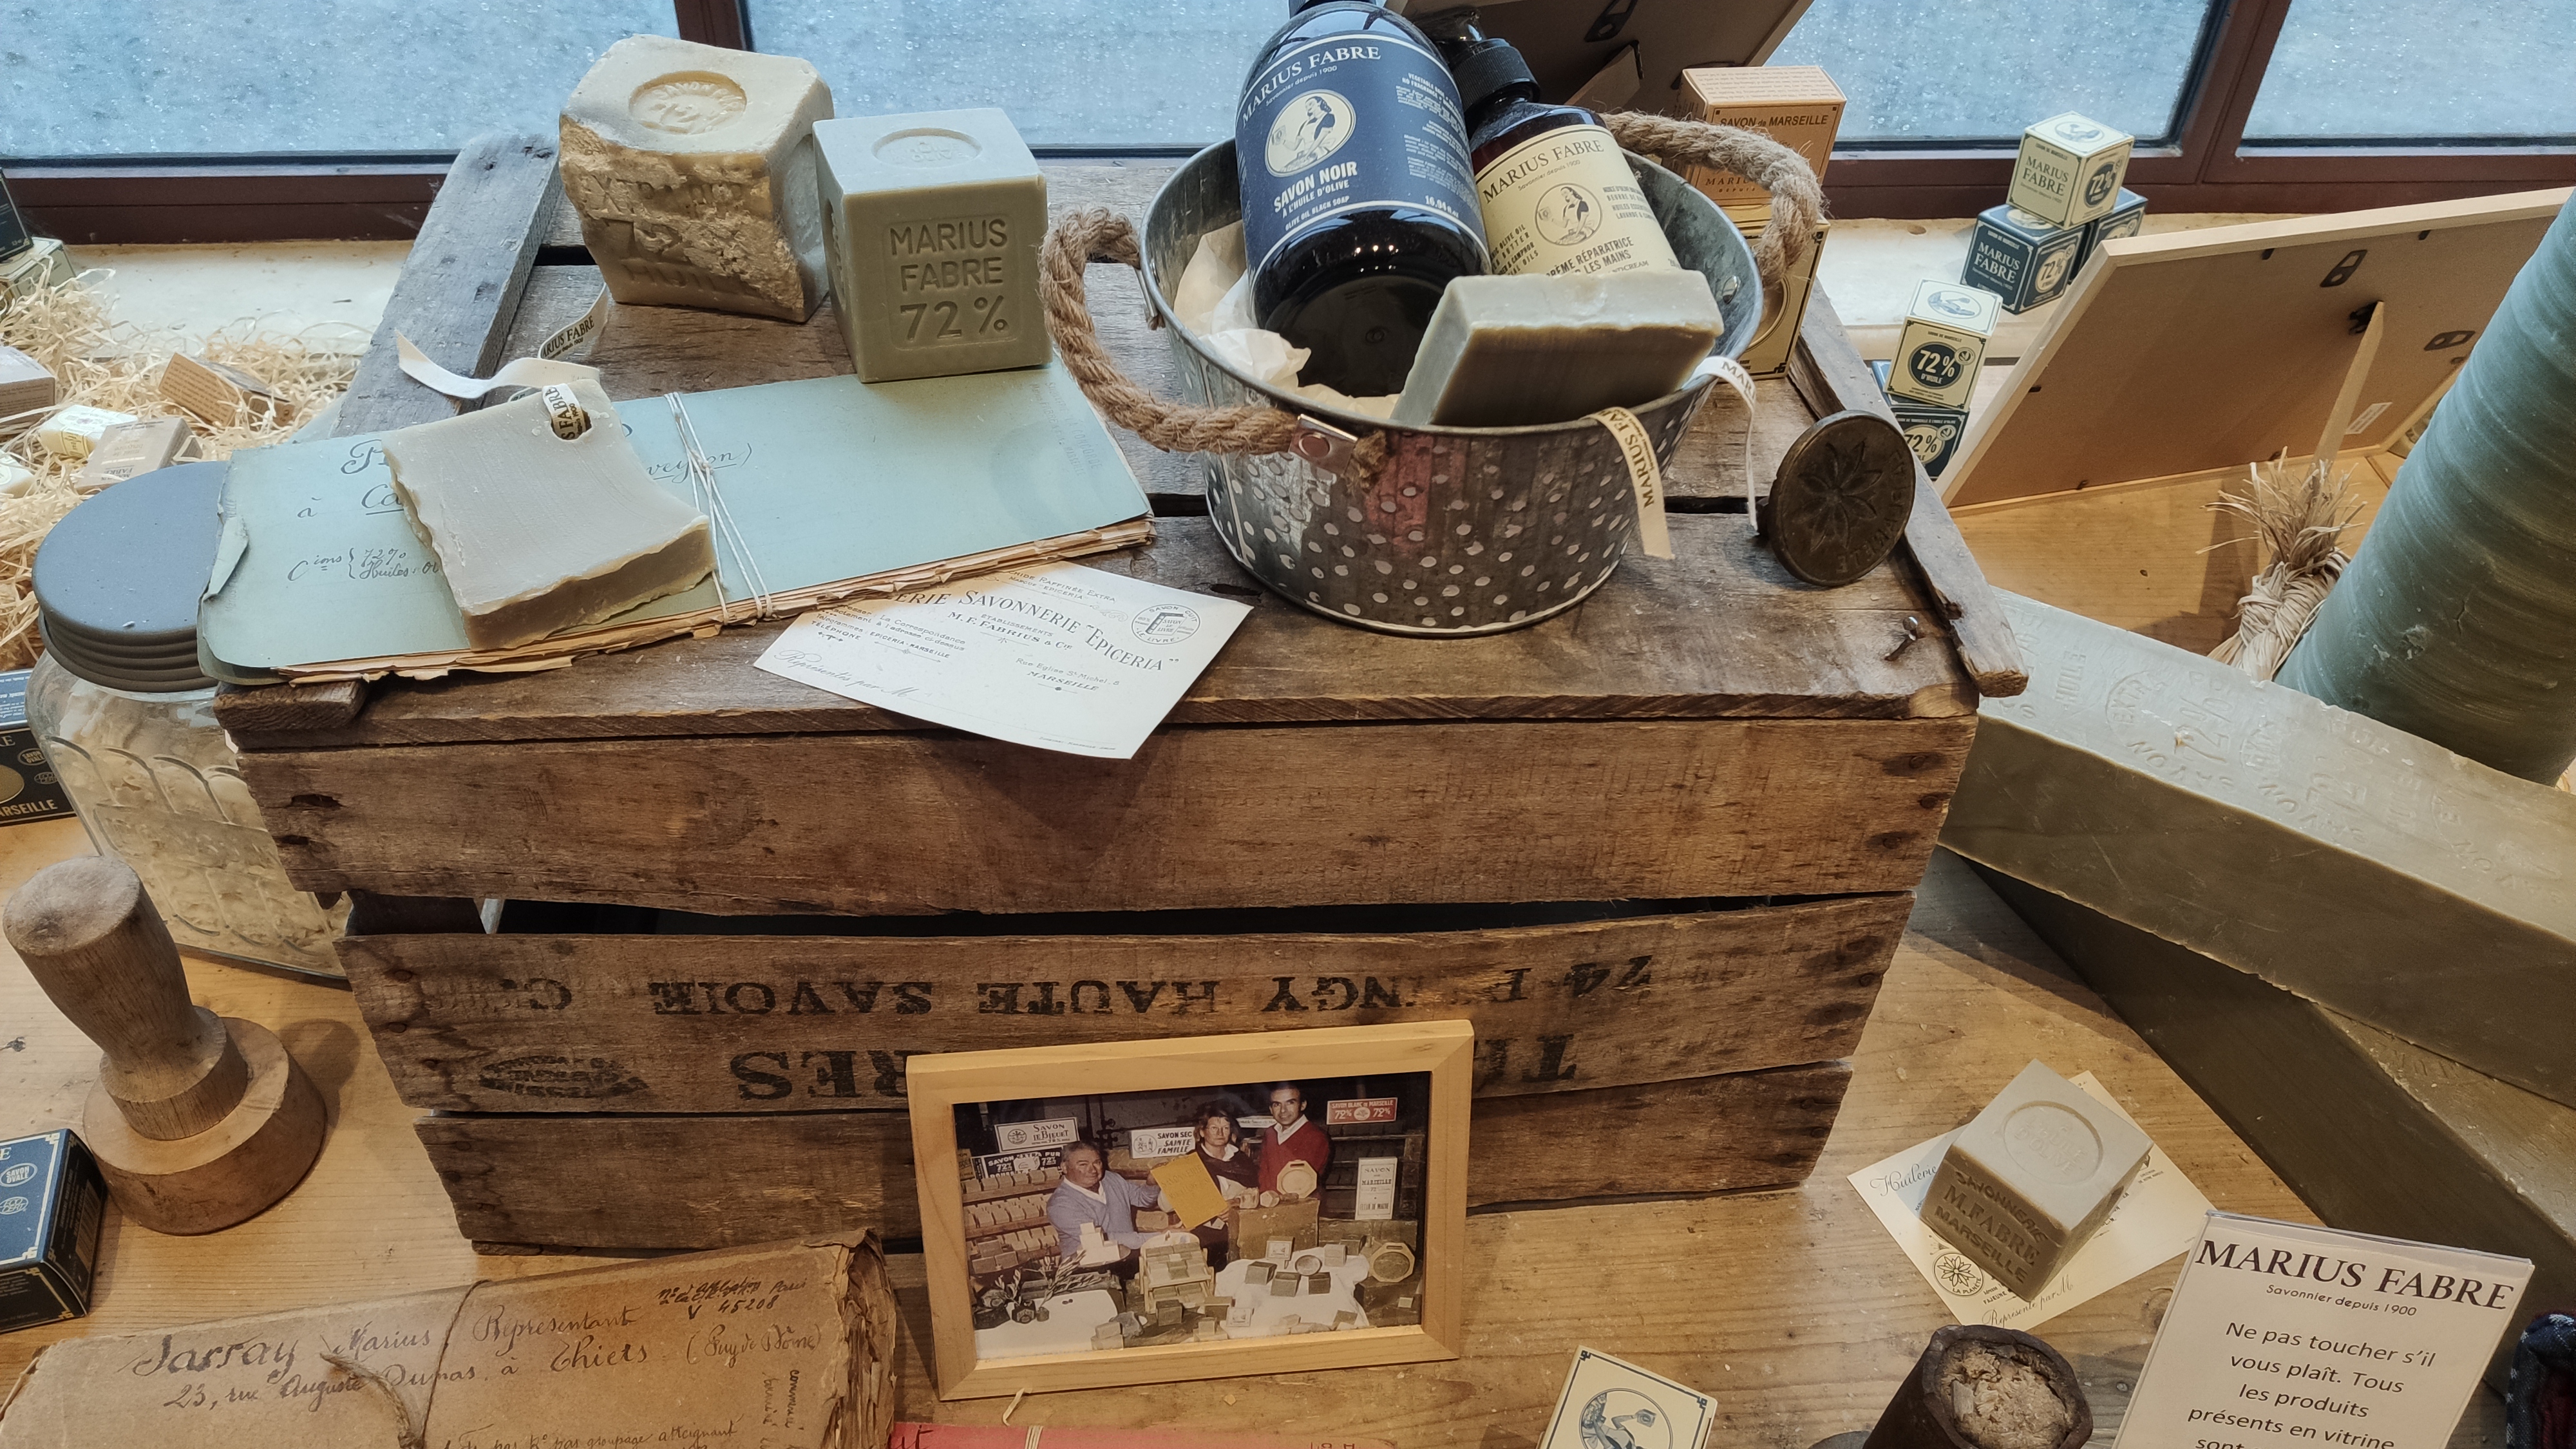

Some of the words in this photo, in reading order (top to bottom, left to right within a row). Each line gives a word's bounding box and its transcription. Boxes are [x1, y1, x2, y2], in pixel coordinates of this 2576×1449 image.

[1242, 62, 1302, 128] MARIUS
[1308, 46, 1381, 69] FABRE
[1266, 83, 1294, 106] Savonnier
[1295, 71, 1317, 85] depuis
[1320, 66, 1338, 75] 1900
[1720, 117, 1757, 127] SAVON
[1769, 115, 1828, 126] MARSEILLE
[1482, 153, 1549, 204] MARIUS
[1552, 140, 1604, 161] FABRE
[1705, 175, 1752, 186] MARI
[2023, 167, 2065, 196] FABRE
[2026, 156, 2069, 182] MARIUS
[1274, 174, 1315, 213] SAVON
[1320, 161, 1358, 184] NOIR
[1289, 191, 1315, 213] L'HUILE
[1317, 180, 1349, 197] D'OLIVE
[1312, 201, 1331, 214] BLACK
[1332, 196, 1350, 205] SOAP
[890, 218, 1007, 256] MARIUS
[1515, 224, 1526, 235] OIL
[1576, 236, 1634, 265] RÉPARATRICE
[1584, 260, 1602, 274] LES
[1604, 249, 1632, 267] MAINS
[1978, 242, 2021, 270] MARIUS
[900, 257, 1003, 292] FABRE
[1974, 252, 2016, 283] FABRE
[542, 333, 564, 358] ARIUS
[567, 315, 595, 341] FABRE
[545, 386, 575, 430] FABRE
[1625, 433, 1654, 509] MARIUS
[1087, 589, 1116, 602] EXTRA
[895, 592, 952, 605] ERIE
[958, 590, 1081, 634] SAVONNERIE
[894, 618, 966, 644] Correspondance
[978, 620, 1041, 643] FABRIUS
[1016, 658, 1034, 667] Rue
[1027, 670, 1100, 691] MARSEILLE
[648, 980, 933, 1015] SAVOIE
[1033, 1123, 1065, 1132] SAVON
[1334, 1110, 1352, 1120] 72%
[1373, 1108, 1391, 1118] 72%
[1157, 1146, 1189, 1155] FAMILLE
[1164, 1139, 1191, 1147] SAINTE
[6, 1166, 30, 1177] SAVON
[988, 1155, 1014, 1166] SAVON
[7, 1173, 29, 1184] OVALE
[1955, 1171, 2048, 1244] SAVONNERIE
[1935, 1205, 2028, 1284] MARSEILLE
[2195, 1238, 2367, 1289] MARIUS
[2374, 1267, 2515, 1310] FABRE
[717, 1294, 780, 1314] 45208
[2266, 1284, 2333, 1304] Savonnier
[2334, 1296, 2380, 1313] depuis
[2383, 1303, 2418, 1317] 1900
[2226, 1322, 2257, 1340] Ne
[2262, 1330, 2302, 1346] pas
[2309, 1336, 2398, 1361] toucher
[225, 1387, 259, 1403] rue
[501, 1356, 518, 1376] à
[2230, 1355, 2282, 1373] vous
[2286, 1363, 2342, 1383] plaît.
[2352, 1372, 2405, 1393] Tous
[2239, 1384, 2270, 1401] les
[2274, 1392, 2370, 1418] produits
[2187, 1408, 2284, 1433] présents
[2289, 1425, 2317, 1439] en
[2324, 1428, 2395, 1449] vitrine
